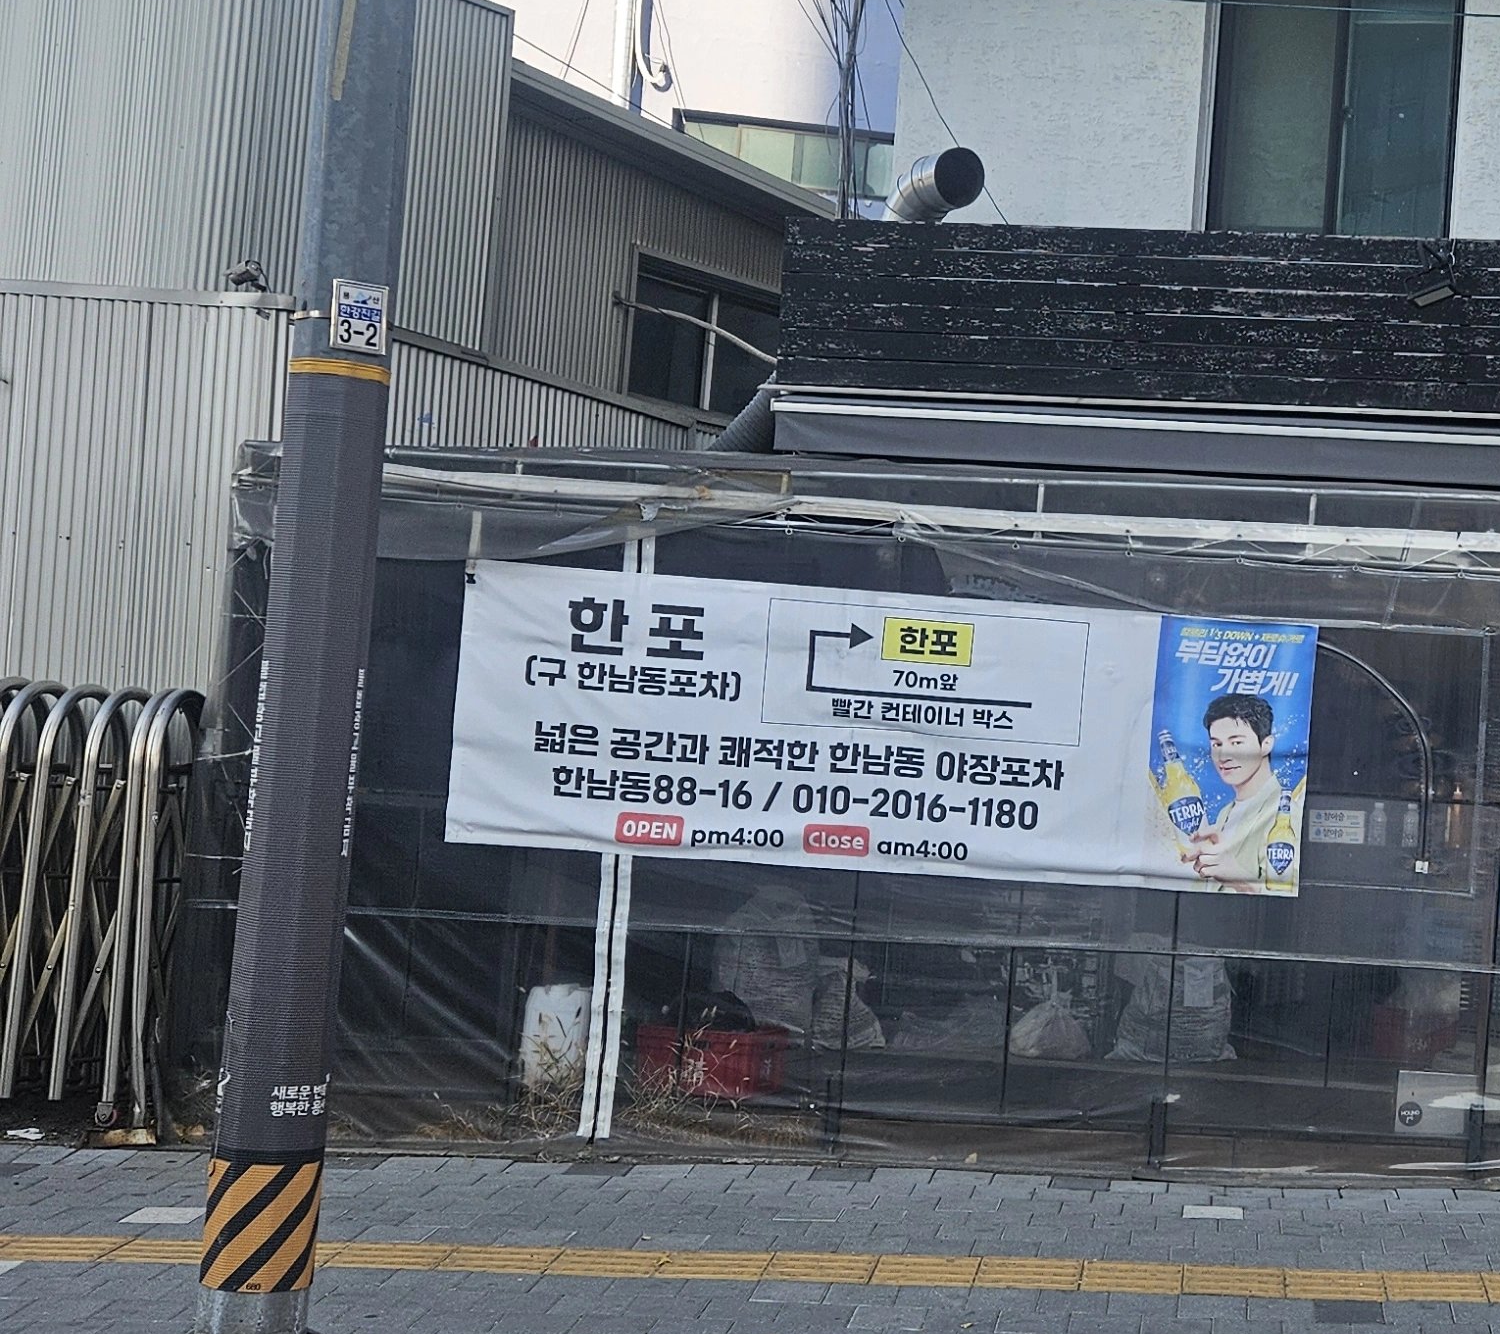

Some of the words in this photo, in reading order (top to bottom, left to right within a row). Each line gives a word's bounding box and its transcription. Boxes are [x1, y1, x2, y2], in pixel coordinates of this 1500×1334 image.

[340, 305, 380, 322] 한강진길
[339, 319, 378, 347] 3-2
[898, 626, 959, 658] 한포
[1223, 629, 1254, 642] DOWN
[1175, 639, 1276, 669] 부담없이
[525, 654, 567, 687] (구
[577, 661, 742, 702] 한남동포차)
[892, 669, 959, 692] 70m앞
[1210, 668, 1299, 697] 가볍게!
[831, 697, 874, 720] 빨간
[880, 701, 965, 728] 컨테이너
[972, 708, 1014, 730] 박스
[533, 720, 600, 757] 넓은
[610, 727, 710, 766] 공간과
[718, 735, 819, 773] 쾌적한
[828, 741, 926, 779] 한남동
[935, 750, 1065, 791] 야장포차
[552, 765, 752, 811] 한남동88-16
[792, 783, 1039, 831] 010-2016-1180
[1169, 801, 1206, 824] TERRA
[622, 819, 678, 841] OPEN
[690, 828, 785, 848] pm4:00
[808, 829, 865, 851] Close
[877, 840, 969, 861] am4:00
[1267, 848, 1294, 860] TERRA
[271, 1085, 312, 1100] 새로운
[270, 1101, 311, 1117] 행복한
